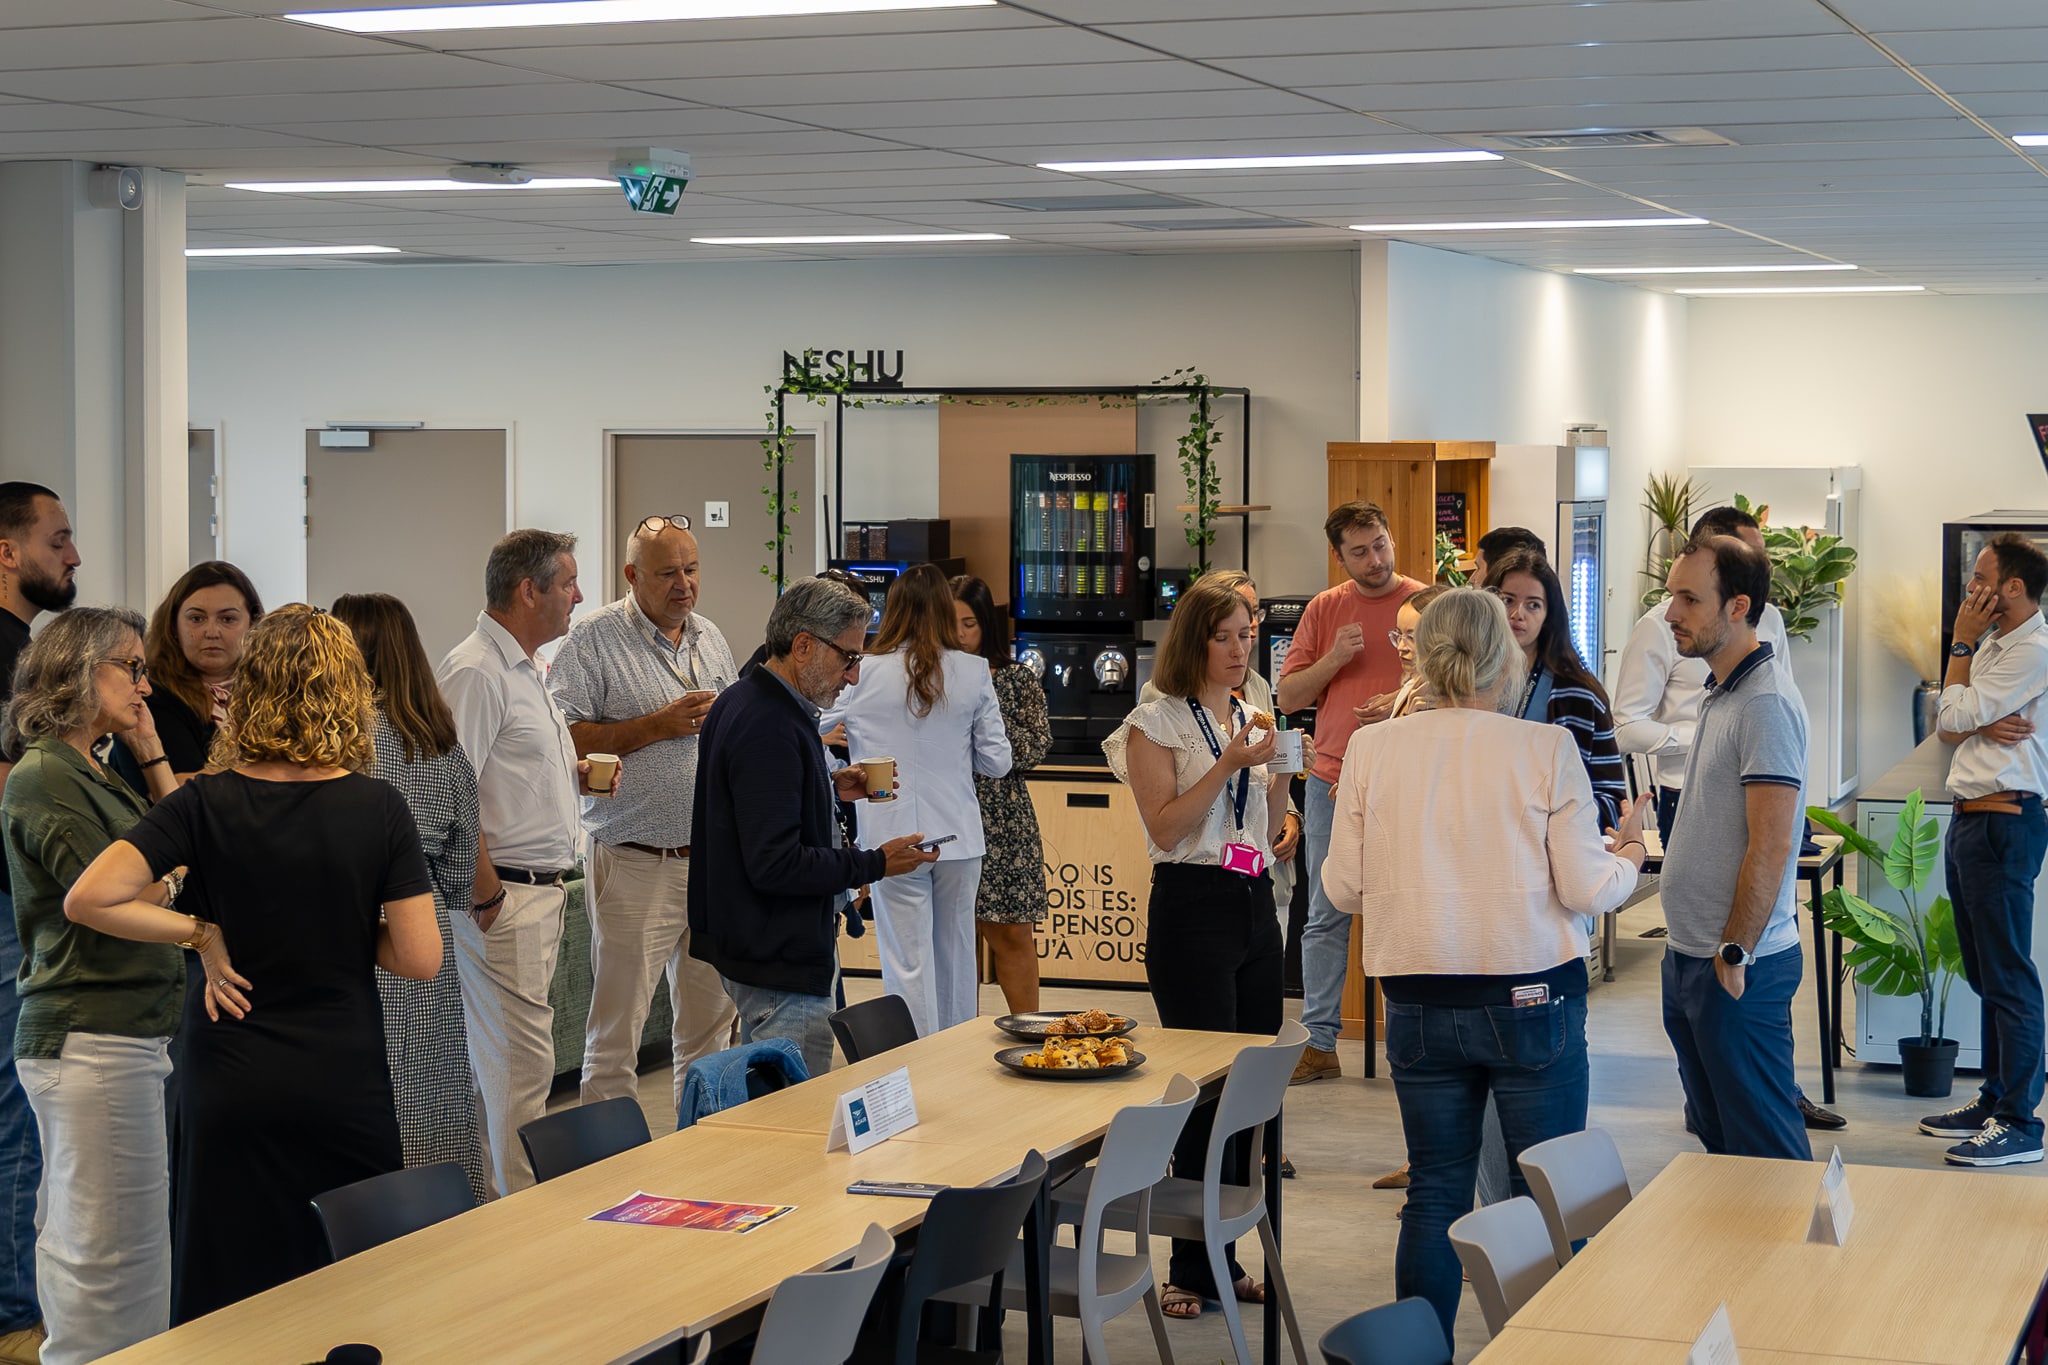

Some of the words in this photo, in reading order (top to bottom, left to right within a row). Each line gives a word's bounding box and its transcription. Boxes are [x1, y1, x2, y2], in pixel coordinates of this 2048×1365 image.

[1048, 471, 1092, 482] NESPRESSO
[1044, 863, 1114, 886] YONS
[1047, 883, 1137, 913] OÏSTES:
[1032, 920, 1045, 933] E
[1052, 914, 1148, 938] PENSON
[1034, 933, 1074, 960] U'À
[1078, 940, 1147, 963] VOUS
